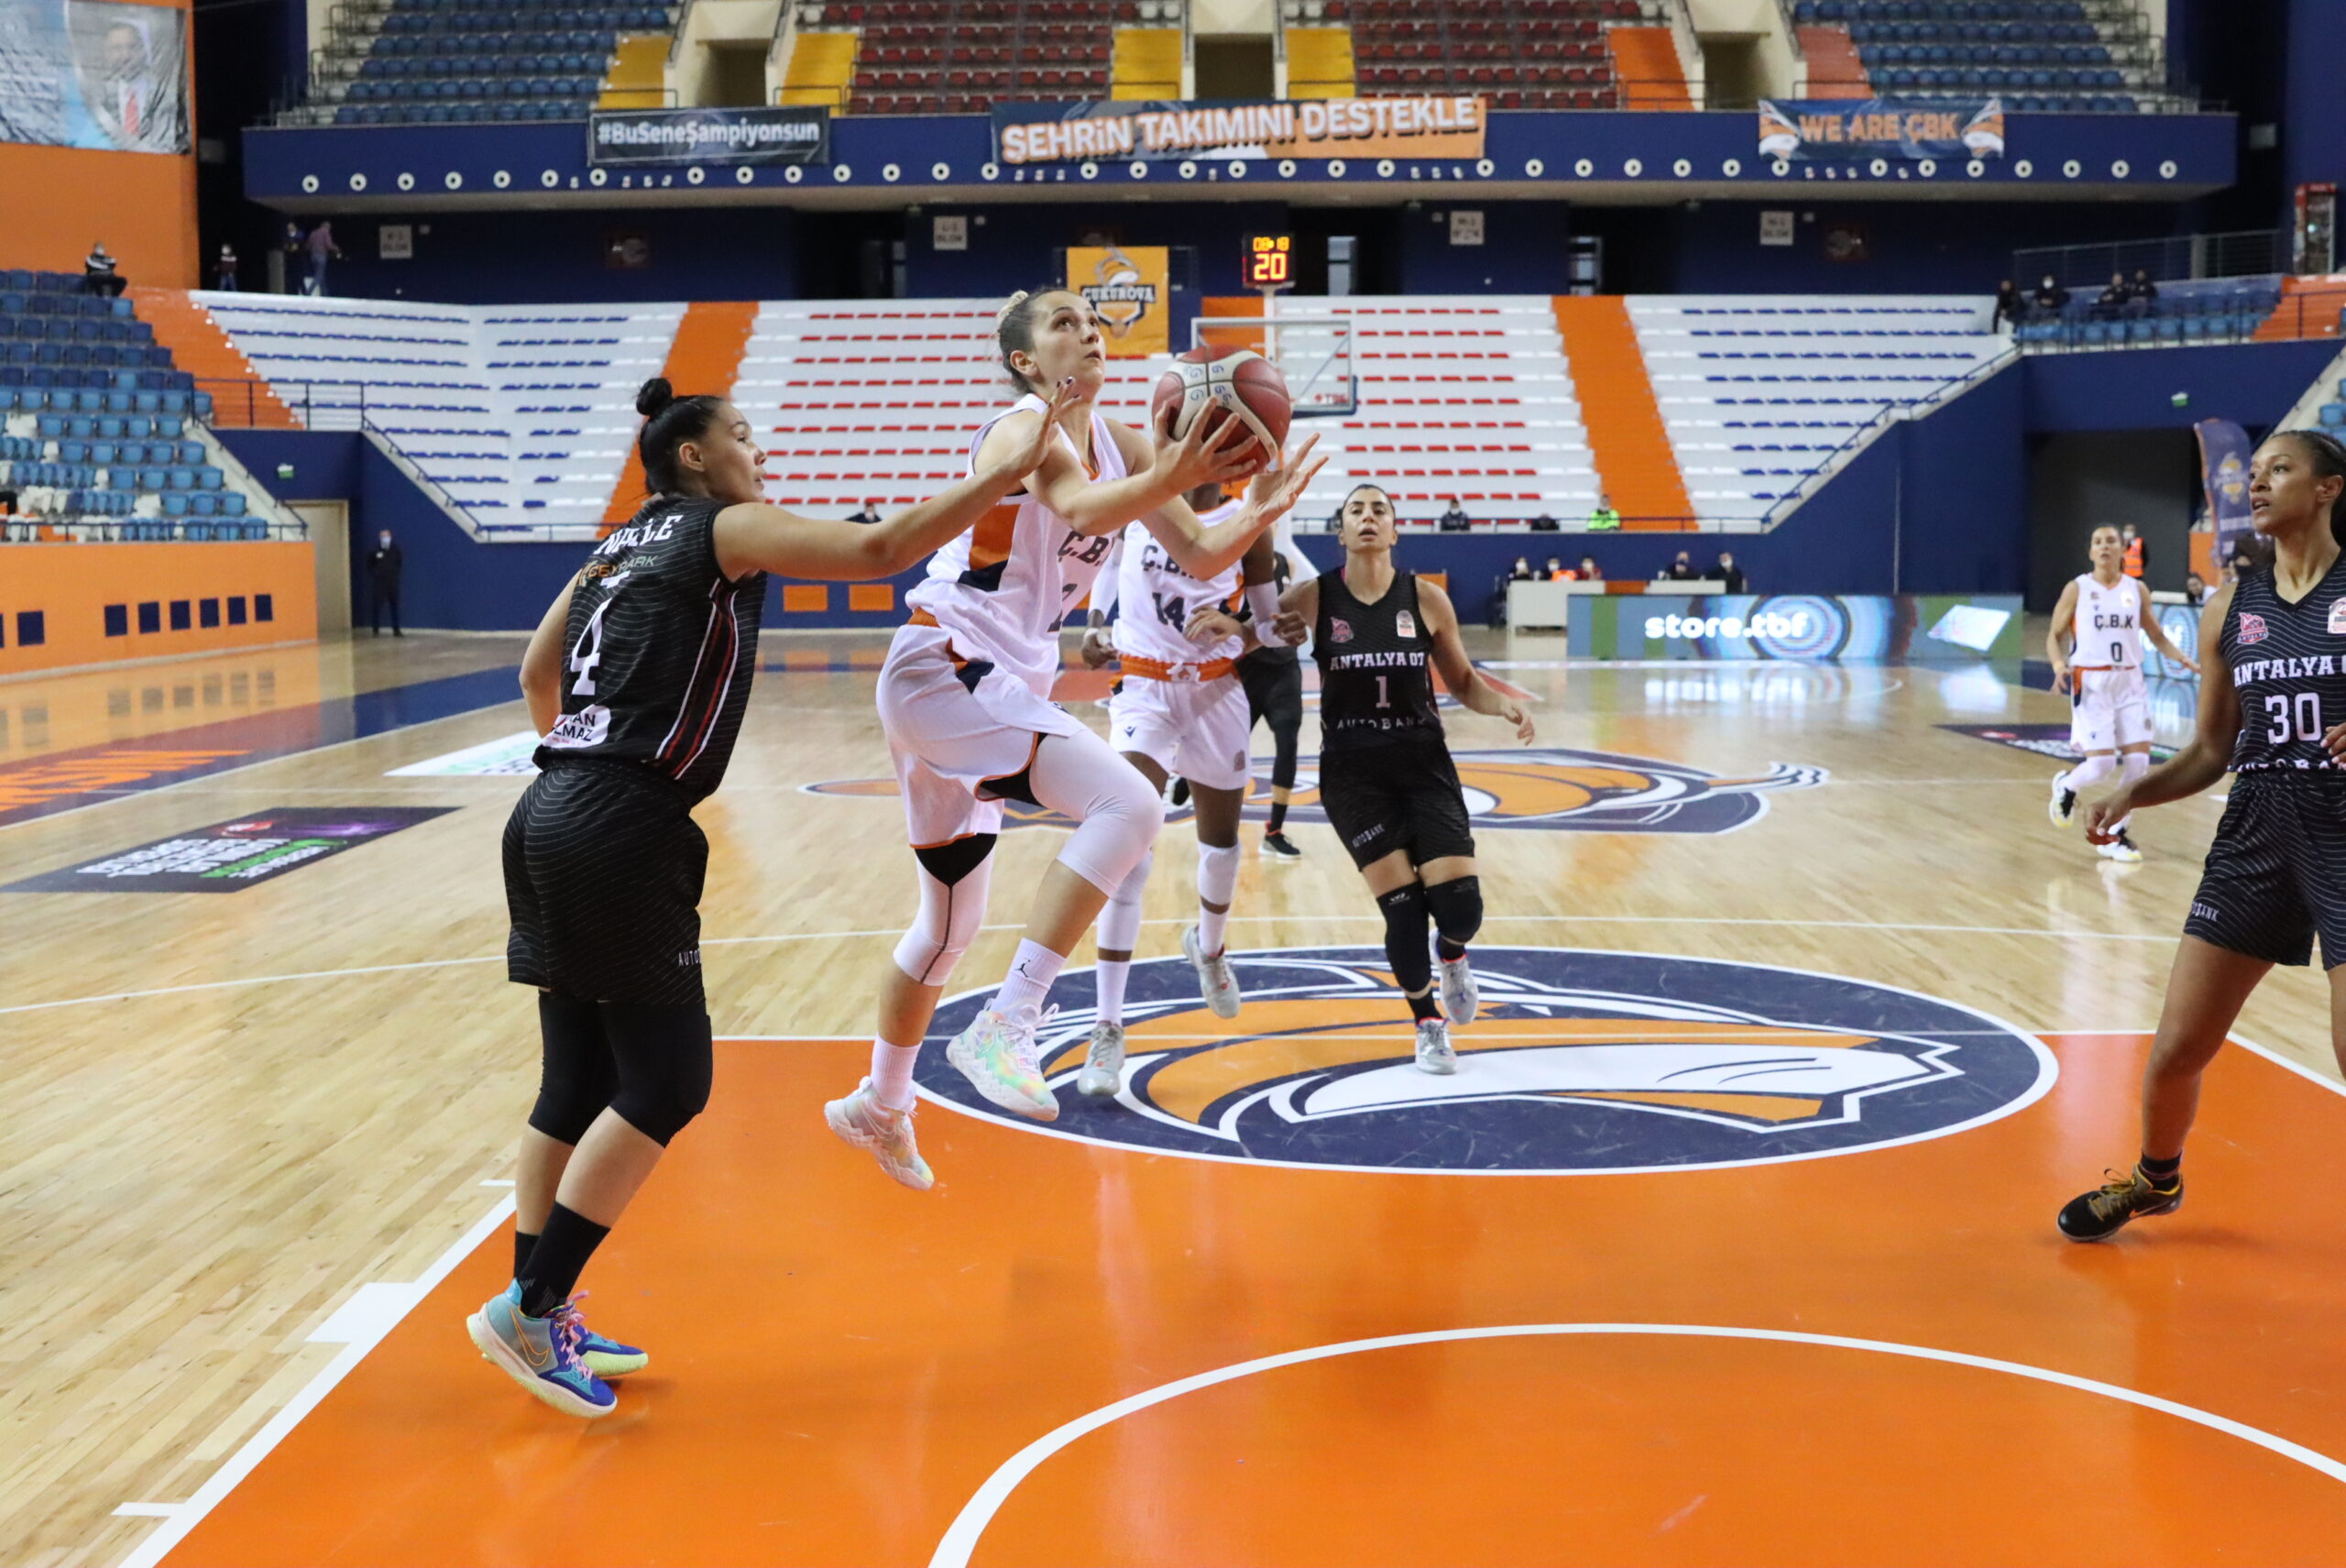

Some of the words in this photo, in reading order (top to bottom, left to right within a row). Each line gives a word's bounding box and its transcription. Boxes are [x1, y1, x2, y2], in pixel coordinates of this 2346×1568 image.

[1301, 96, 1478, 137] DESTEKLE
[1798, 115, 1843, 142] WE
[1848, 113, 1901, 141] ARE
[597, 117, 821, 150] #BuSeneŞampiyonsun
[1254, 253, 1287, 280] 20
[1152, 591, 1185, 633] 14
[1645, 611, 1808, 639] store.tbf
[1330, 652, 1408, 671] ANTALYA
[1409, 652, 1424, 666] 07
[2110, 641, 2122, 663] 0
[2233, 655, 2336, 688] ANTALYA
[1376, 675, 1391, 708] 1
[2264, 692, 2322, 744] 30
